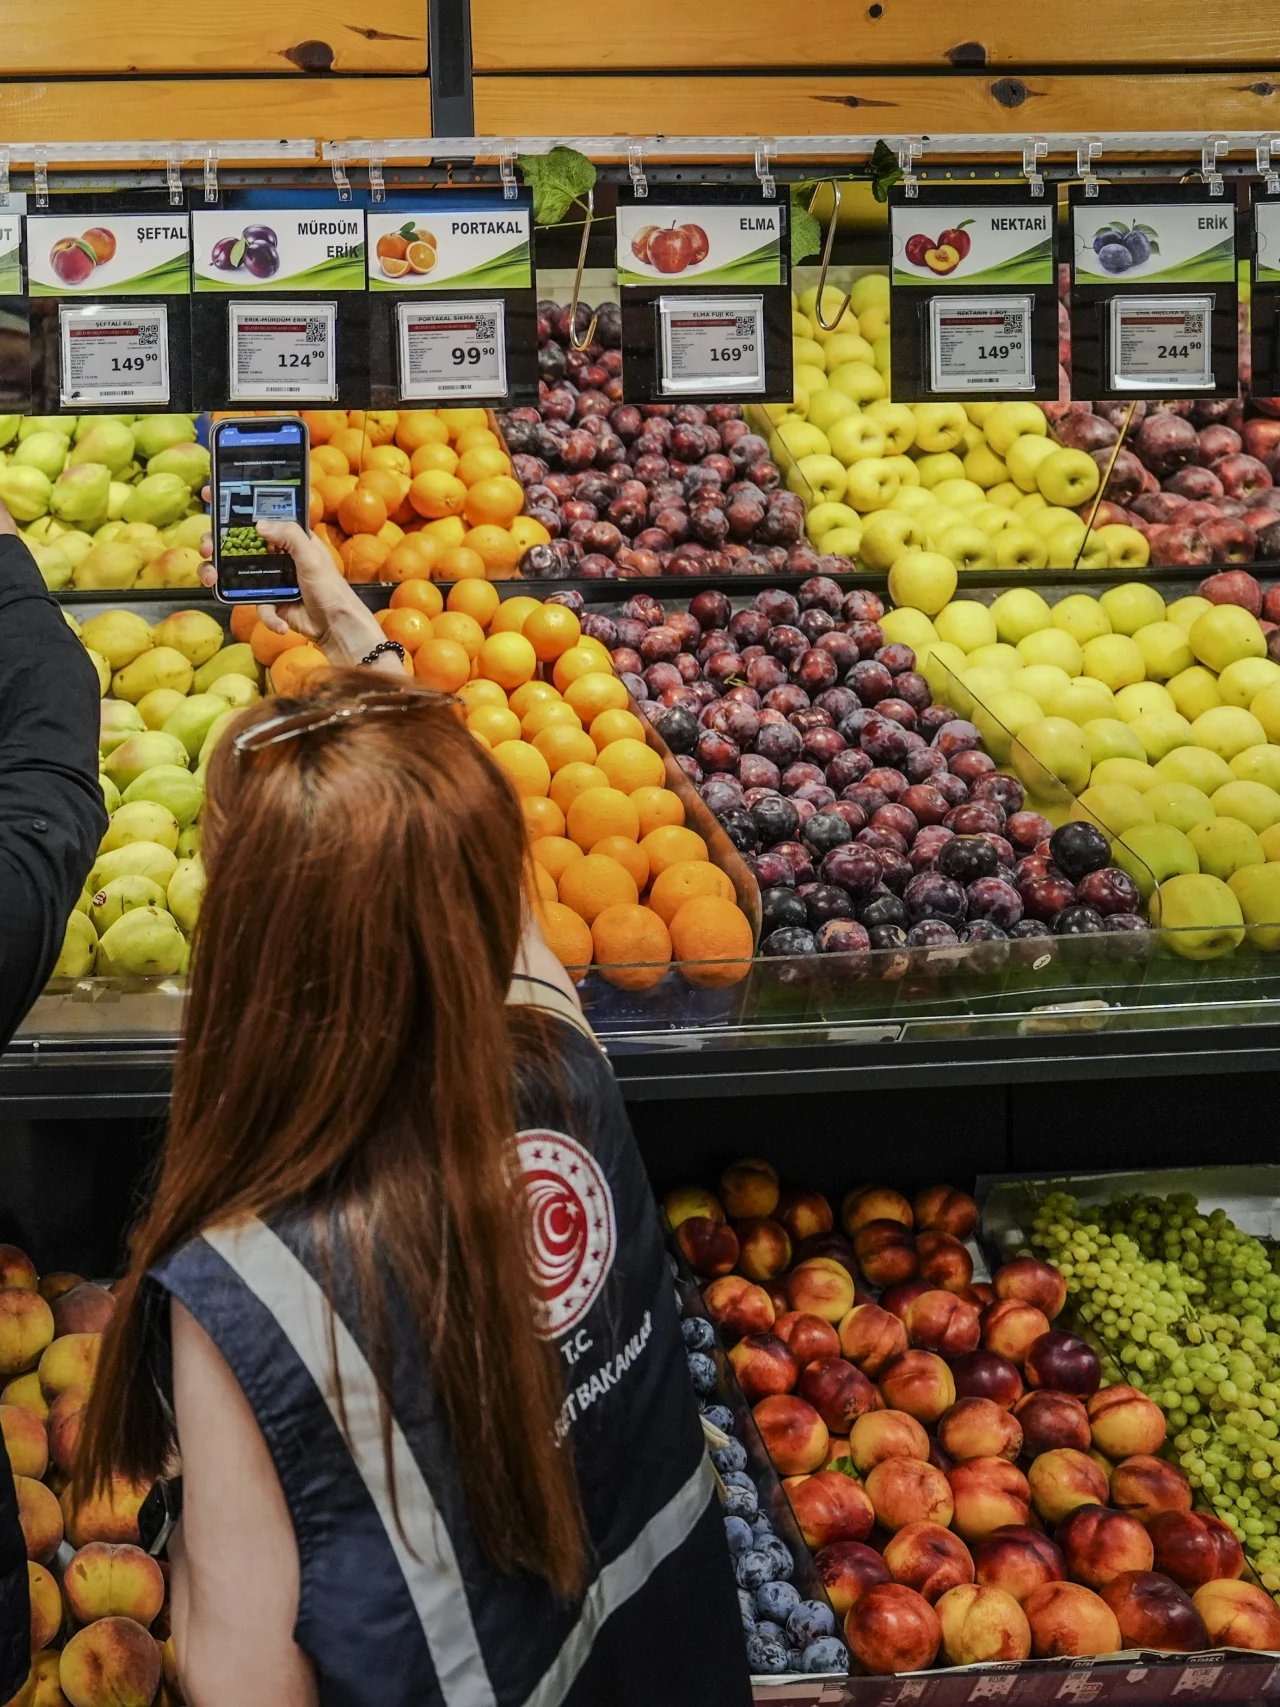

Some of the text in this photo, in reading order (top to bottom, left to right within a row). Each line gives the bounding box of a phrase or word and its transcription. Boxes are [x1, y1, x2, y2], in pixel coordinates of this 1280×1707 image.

[298, 220, 358, 236] MÜRDÜM
[452, 221, 522, 235] PORTAKAL
[740, 218, 775, 231] ELMA
[991, 215, 1047, 231] NEKTARİ
[1197, 214, 1228, 230] ERİK
[327, 242, 359, 258] ERİK
